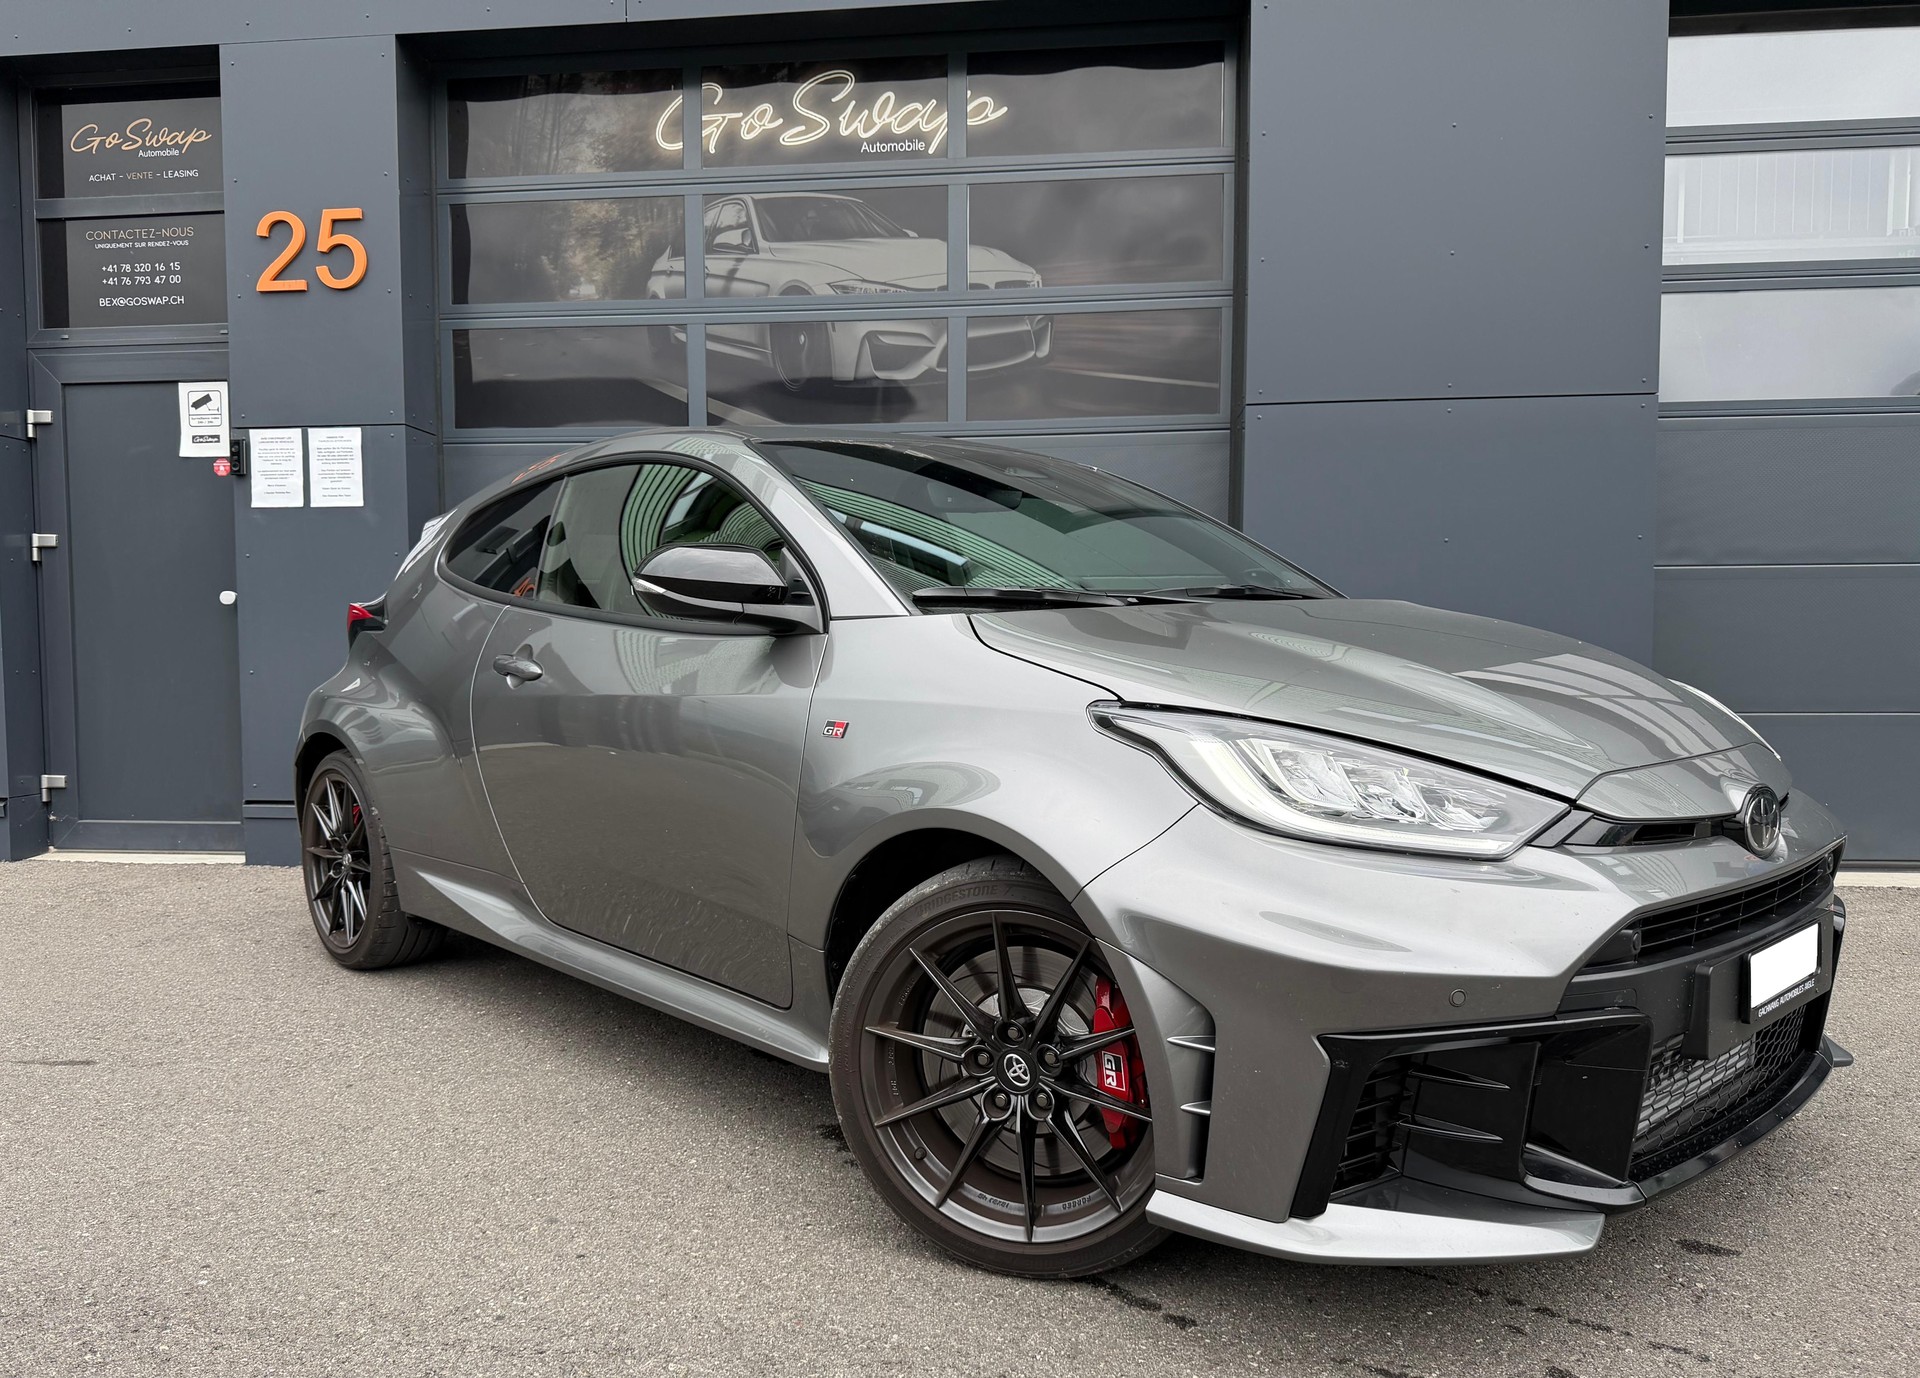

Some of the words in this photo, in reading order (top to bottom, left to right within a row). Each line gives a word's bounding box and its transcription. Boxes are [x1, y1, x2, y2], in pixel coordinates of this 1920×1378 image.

[70, 118, 212, 154] GoSwap
[138, 148, 180, 158] Automobile
[860, 140, 926, 153] Automobile
[88, 173, 116, 182] ACHAT
[126, 171, 153, 180] VENTE
[163, 169, 199, 179] LEASING
[85, 226, 195, 241] CONTACTEZ-NOUS
[256, 207, 368, 292] 25
[101, 264, 118, 273] +41
[120, 263, 132, 273] 78
[134, 262, 151, 272] 320
[154, 262, 166, 271] 16
[169, 261, 181, 271] 15
[102, 277, 118, 286] +41
[120, 276, 132, 286] 76
[134, 275, 151, 285] 793
[154, 275, 166, 285] 47
[169, 274, 181, 284] 00
[99, 295, 185, 307] BEX@GOSWAP.CH
[823, 726, 843, 737] GR
[1104, 1053, 1117, 1087] GR
